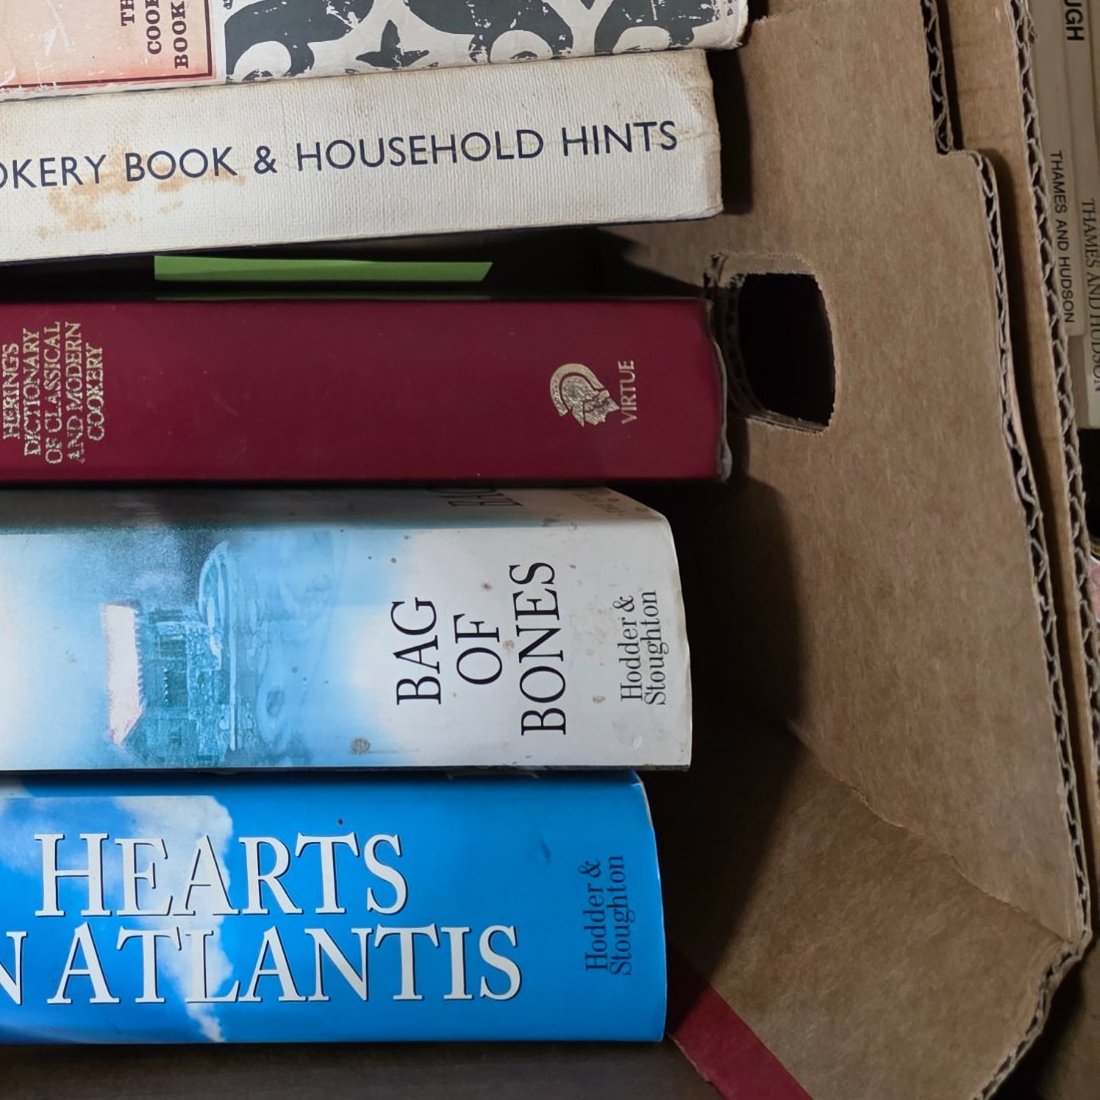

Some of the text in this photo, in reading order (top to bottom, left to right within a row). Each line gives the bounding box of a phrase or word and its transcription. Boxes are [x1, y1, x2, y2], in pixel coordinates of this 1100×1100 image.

[170, 0, 190, 70] BOOK
[124, 145, 239, 183] BOOK
[252, 144, 279, 176] &
[296, 129, 545, 173] HOUSEHOLD
[561, 118, 680, 158] HINTS
[1050, 149, 1076, 324] THAMES AND HUDSON
[1082, 196, 1100, 269] THAMES
[22, 327, 42, 457] DICTIONARY
[43, 320, 63, 465] OF CLASSICAL
[64, 321, 86, 464] AND MODERN
[85, 341, 106, 442] COOKERY
[617, 359, 638, 425] VIRTUE
[389, 596, 442, 706] BAG
[452, 612, 504, 686] OF
[508, 561, 567, 737] BONES
[611, 594, 643, 703] Hodder &
[640, 589, 670, 706] Stoughton
[33, 831, 411, 919] HEARTS
[577, 859, 609, 972] Hodder &
[605, 854, 636, 977] Stoughton
[45, 921, 525, 1006] ATLANTIS
